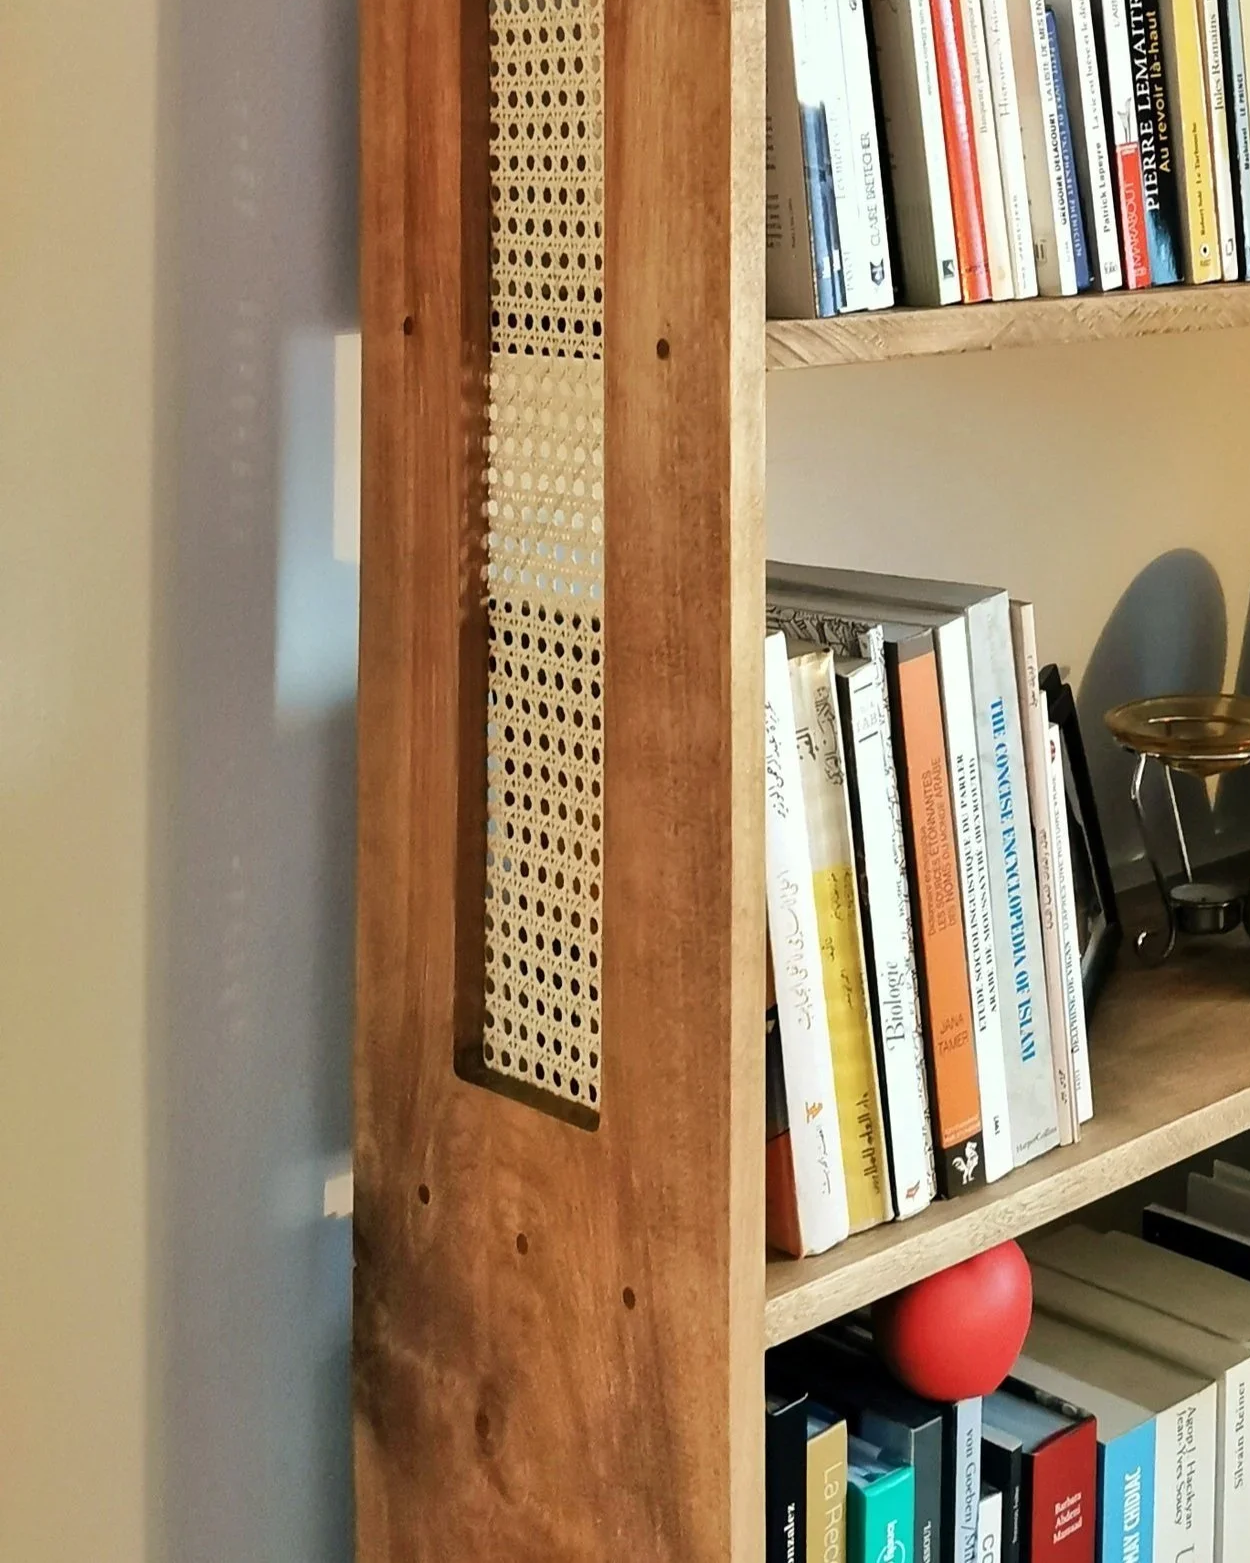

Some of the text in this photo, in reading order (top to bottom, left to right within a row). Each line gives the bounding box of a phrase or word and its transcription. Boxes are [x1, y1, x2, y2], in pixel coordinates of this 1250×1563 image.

[1037, 18, 1047, 40] MES
[1040, 45, 1048, 57] DE
[1207, 14, 1225, 112] Jules Romains
[1145, 10, 1172, 173] Au revoir là-haut
[1236, 73, 1246, 117] LE PRINCE
[1049, 113, 1062, 171] DELACOURT
[1139, 120, 1160, 212] PIERRE
[1095, 142, 1112, 233] Patrick Lapeyre
[868, 204, 881, 247] CLAIRE
[1125, 181, 1141, 269] MARABOUT
[930, 756, 944, 798] ARABE
[956, 754, 970, 809] PARLER
[936, 800, 948, 844] MONDE
[962, 814, 970, 833] DU
[942, 844, 950, 859] DU
[989, 697, 1036, 1062] THE CONCISE ENCYCLOPEDIA OF ISLAM
[931, 858, 947, 931] LES SOURCES
[940, 862, 955, 903] NOMS
[880, 960, 906, 1050] Biologie
[985, 949, 999, 1014] ARABE DE
[1065, 977, 1075, 994] DE
[964, 1428, 975, 1457] von
[1234, 1381, 1245, 1489] Silvain Reiner
[823, 1461, 844, 1500] La
[1174, 1411, 1188, 1526] Jean-Yves Soucy
[1184, 1407, 1197, 1530] Agop Hacikyan
[1054, 1491, 1082, 1515] Barbara
[1122, 1466, 1141, 1563] MAY CHIDIAC
